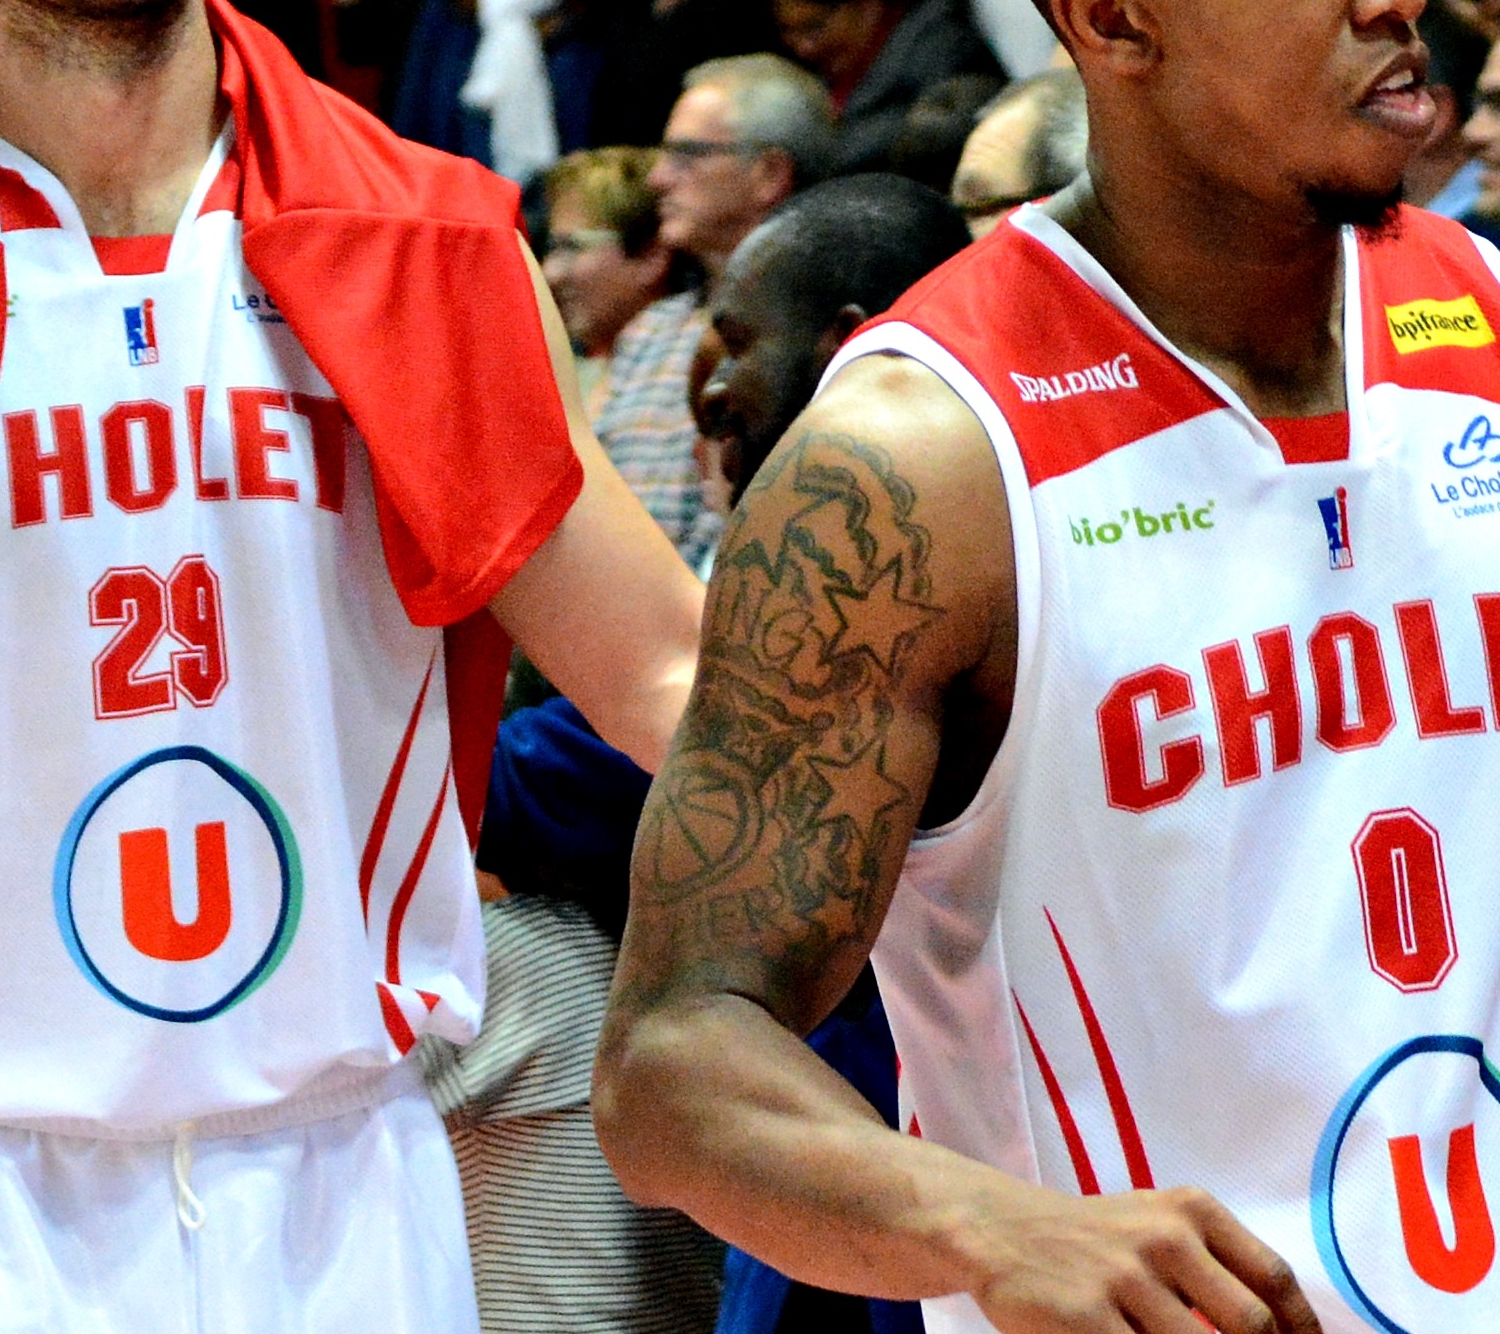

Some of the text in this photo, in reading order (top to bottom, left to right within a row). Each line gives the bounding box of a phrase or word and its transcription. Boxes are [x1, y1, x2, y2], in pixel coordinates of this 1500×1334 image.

[1009, 352, 1139, 402] SPALDING
[1431, 482, 1460, 504] Le
[88, 553, 229, 721] 29
[118, 820, 232, 962] U
[1350, 805, 1459, 994] 0
[1387, 1122, 1495, 1295] U
